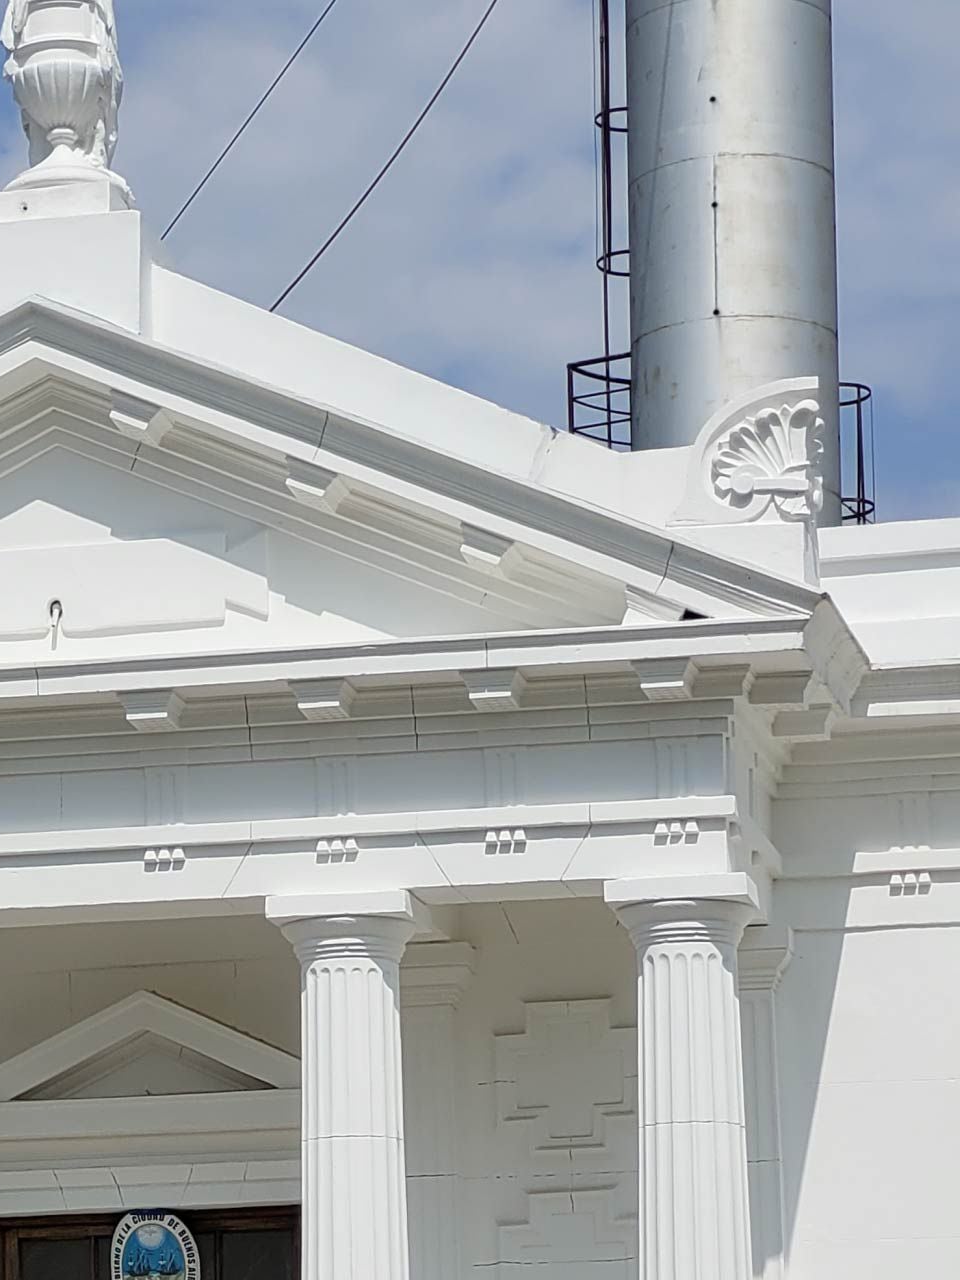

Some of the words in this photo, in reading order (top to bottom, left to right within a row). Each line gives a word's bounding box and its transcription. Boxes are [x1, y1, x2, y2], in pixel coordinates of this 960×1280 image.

[117, 1233, 125, 1245] DE
[121, 1223, 132, 1234] LA
[167, 1218, 180, 1230] DE
[178, 1229, 196, 1264] BUENOS
